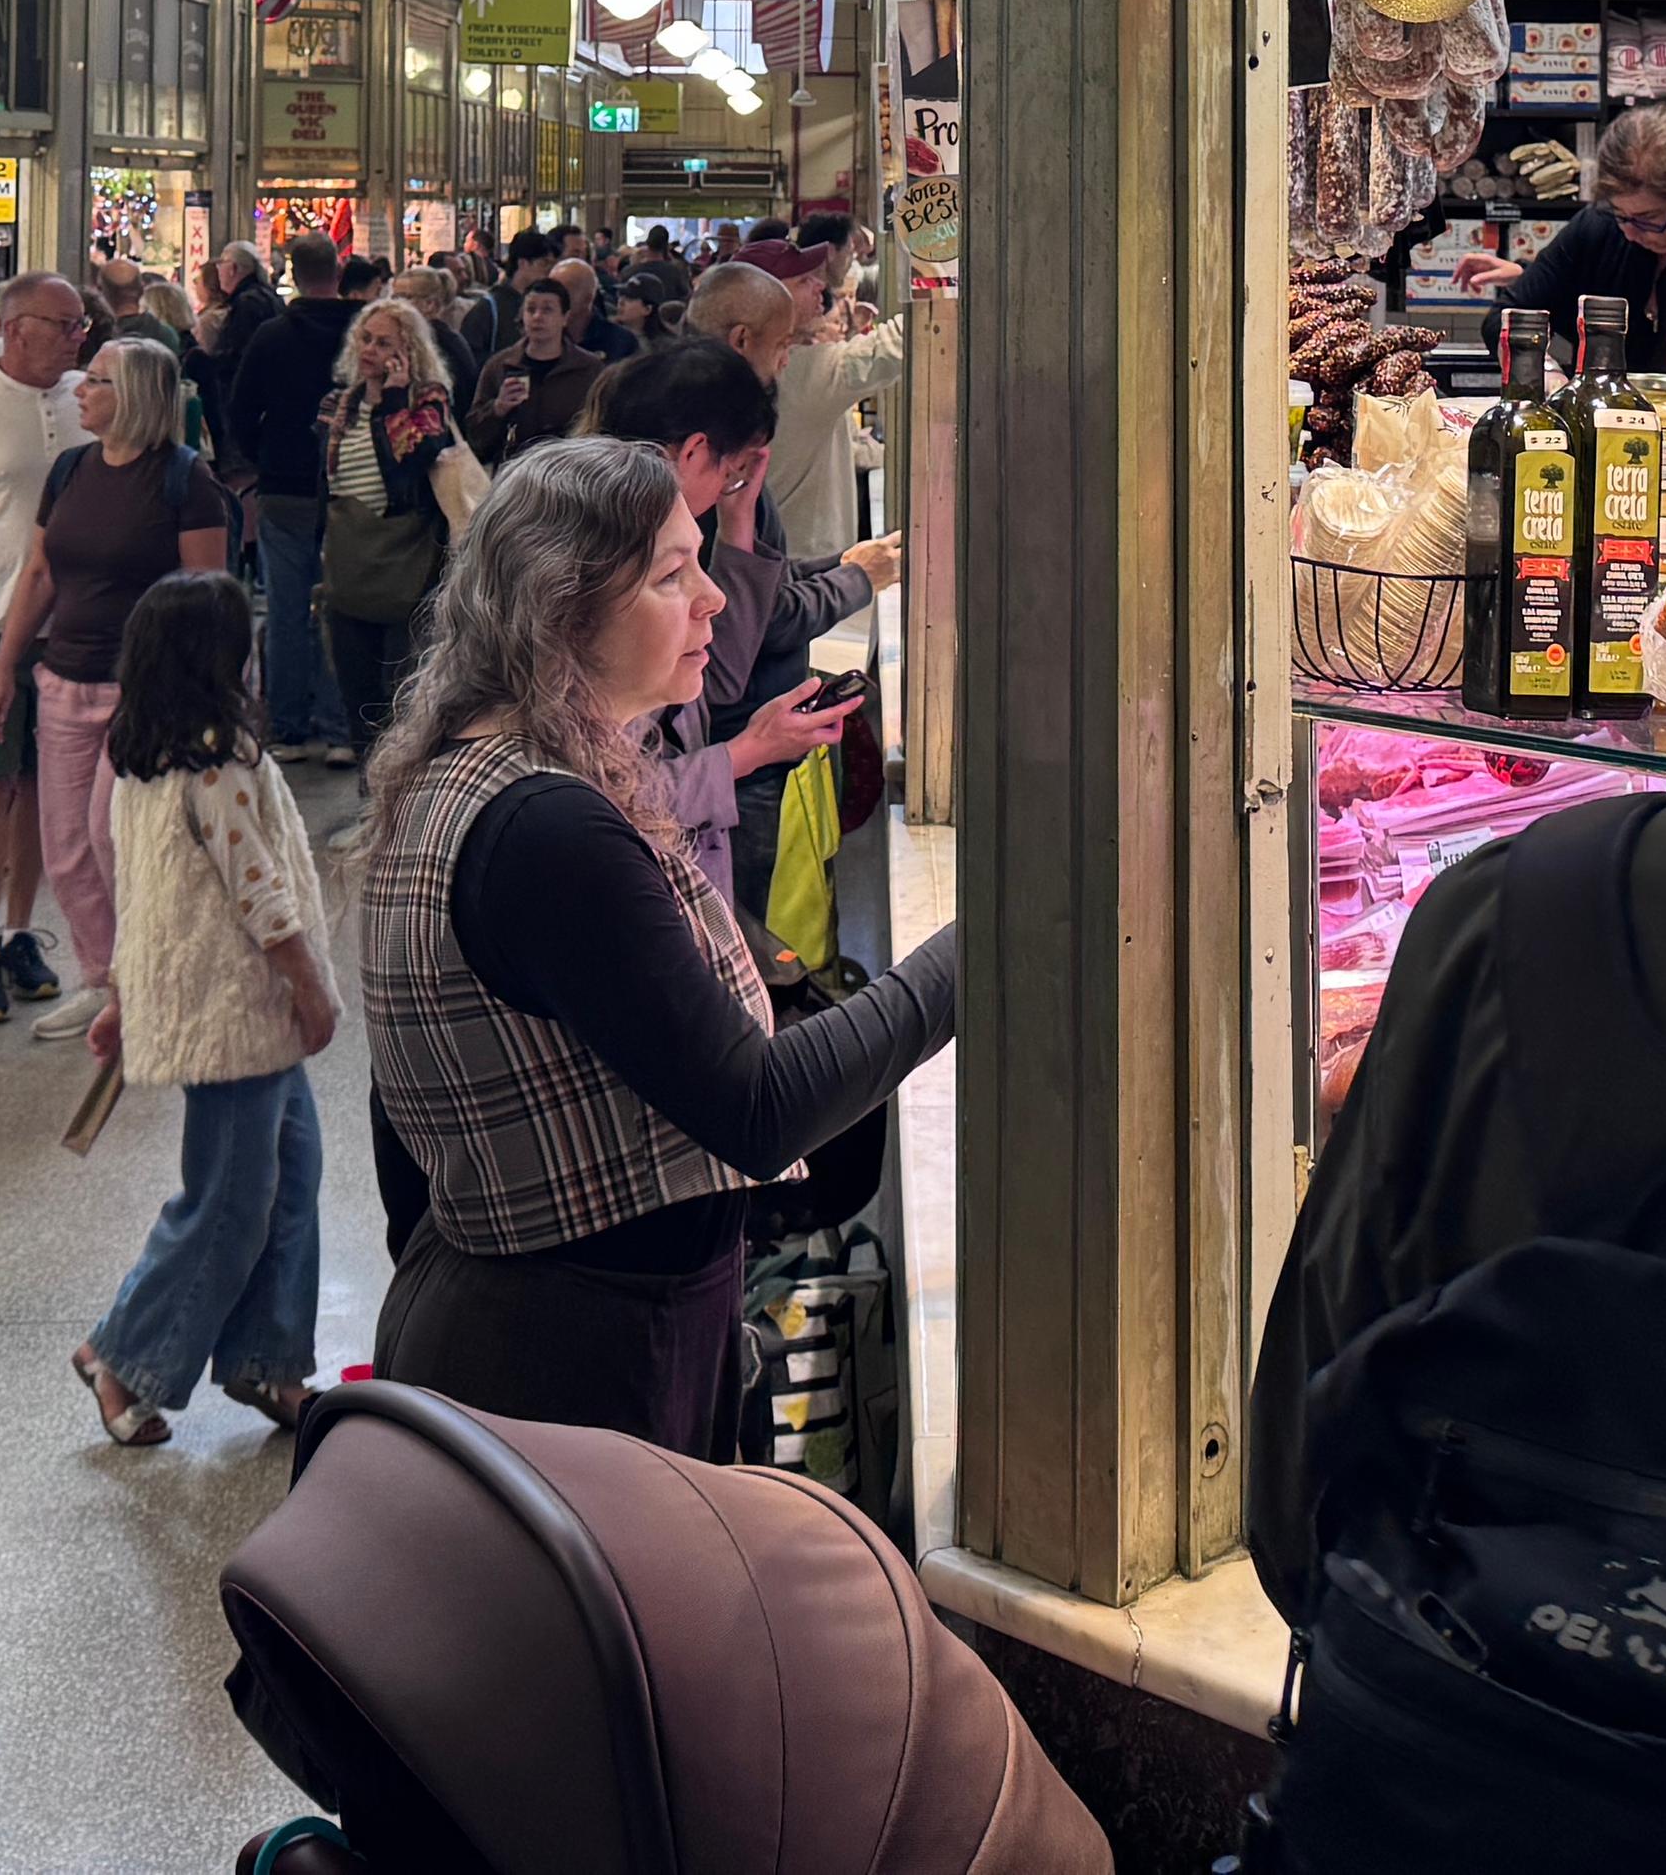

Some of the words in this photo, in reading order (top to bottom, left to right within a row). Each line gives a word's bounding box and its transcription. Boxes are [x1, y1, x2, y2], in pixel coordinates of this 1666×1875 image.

[506, 25, 567, 36] VEGETABLES
[506, 37, 543, 47] STREET
[468, 48, 506, 58] TOILETS
[295, 91, 326, 103] THE
[286, 103, 338, 116] QUEEN
[298, 116, 323, 128] VIC
[291, 129, 327, 141] DELI
[903, 181, 952, 206] VOTED
[901, 191, 960, 233] Best
[1606, 463, 1649, 493] terra
[1523, 486, 1564, 516] terra
[1604, 493, 1648, 522] creta
[1522, 515, 1564, 542] creta
